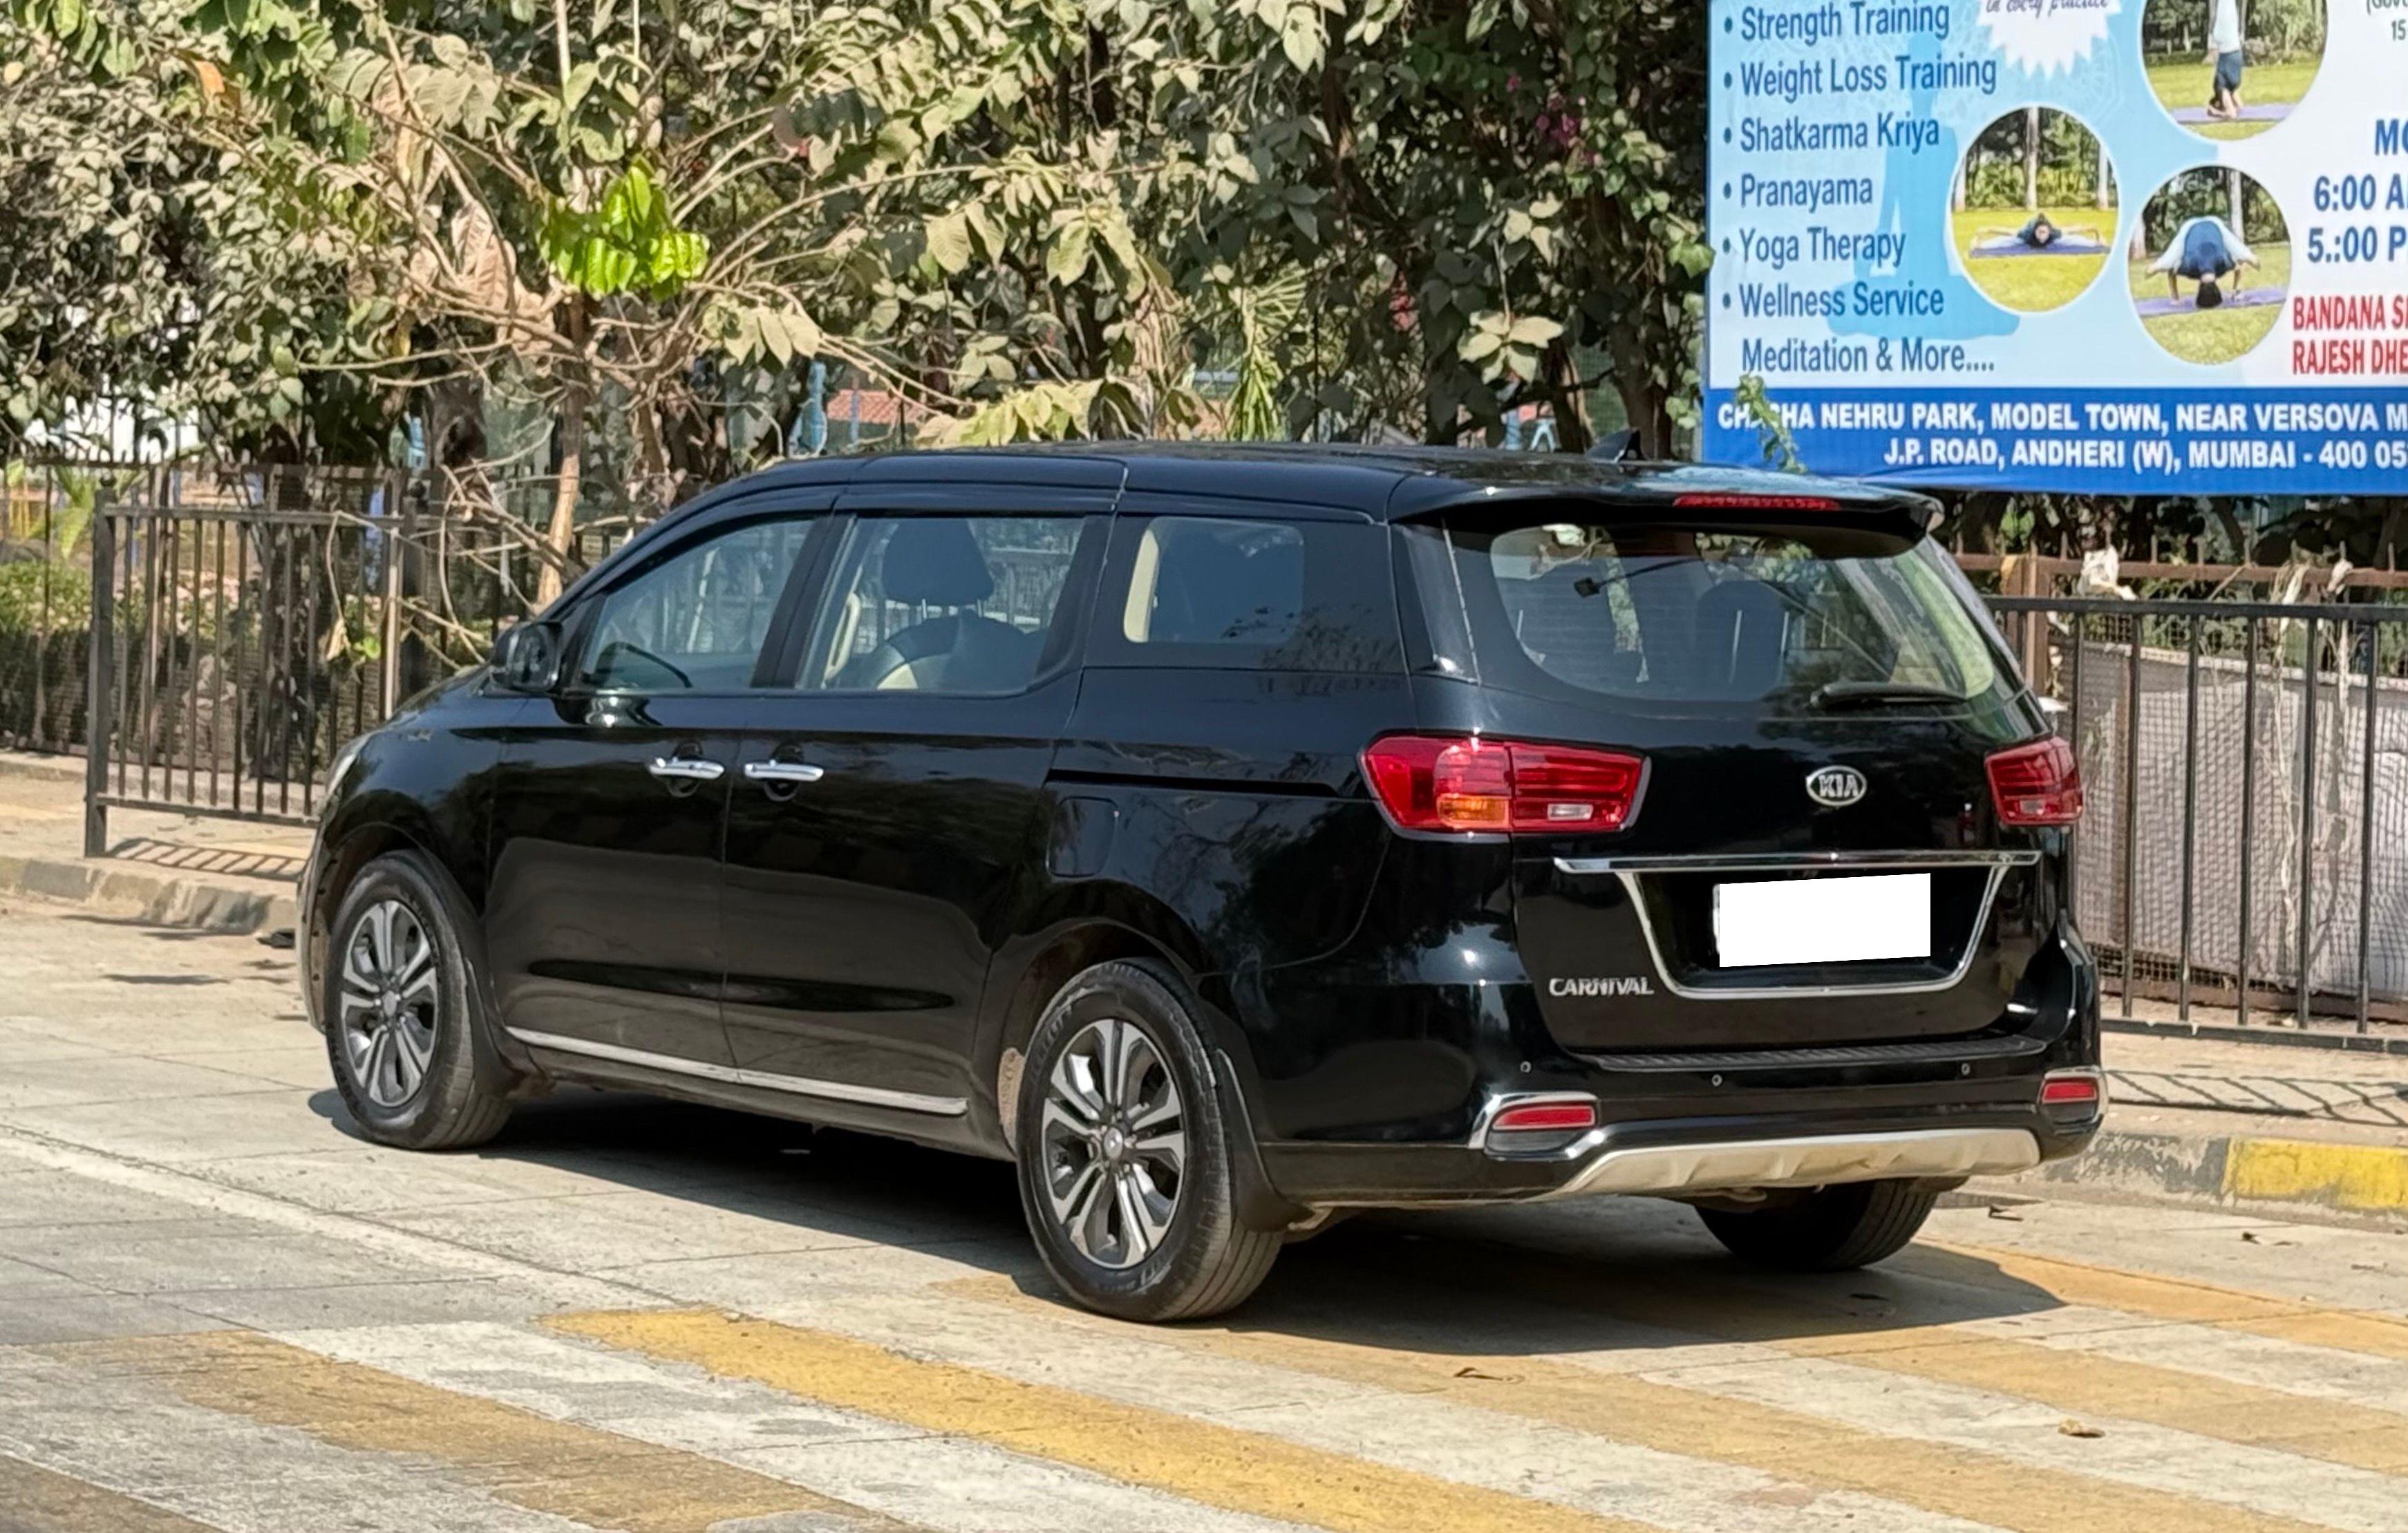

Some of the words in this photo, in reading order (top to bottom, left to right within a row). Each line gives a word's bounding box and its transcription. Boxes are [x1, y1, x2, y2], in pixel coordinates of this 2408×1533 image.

[1740, 5, 1842, 46] Strength
[1850, 0, 1950, 40] Training
[1741, 59, 1823, 104] Weight
[1830, 58, 1887, 93] Loss
[1895, 53, 1997, 95] Training
[1740, 115, 1868, 153] Shatkarma
[1877, 111, 1939, 155] Kriya
[1740, 173, 1873, 214] Pranayama
[2313, 173, 2377, 212] 6:00
[1739, 227, 1799, 269] Yoga
[1807, 226, 1906, 267] Therapy
[1739, 283, 1845, 317] Wellness
[1853, 280, 1944, 317] Service
[2293, 295, 2386, 331] BANDANA
[1742, 337, 1868, 373] Meditation
[1876, 337, 1893, 372] &
[2293, 339, 2365, 375] RAJESH
[1821, 402, 1905, 429] NEHRU
[1912, 402, 1984, 434] PARK,
[1991, 402, 2078, 431] MODEL
[2085, 403, 2169, 435] TOWN,
[2176, 403, 2248, 432] NEAR
[2254, 403, 2380, 432] VERSOVA
[1883, 438, 1924, 465] J.P.
[1931, 438, 2005, 471] ROAD,
[2011, 439, 2125, 468] ANDHERI
[2133, 439, 2181, 475] (W),
[2189, 440, 2295, 469] MUMBAI
[2319, 440, 2368, 469] 400
[2374, 440, 2408, 469] 05
[1818, 773, 1859, 798] KIA
[1549, 976, 1655, 997] CARNIVAL
